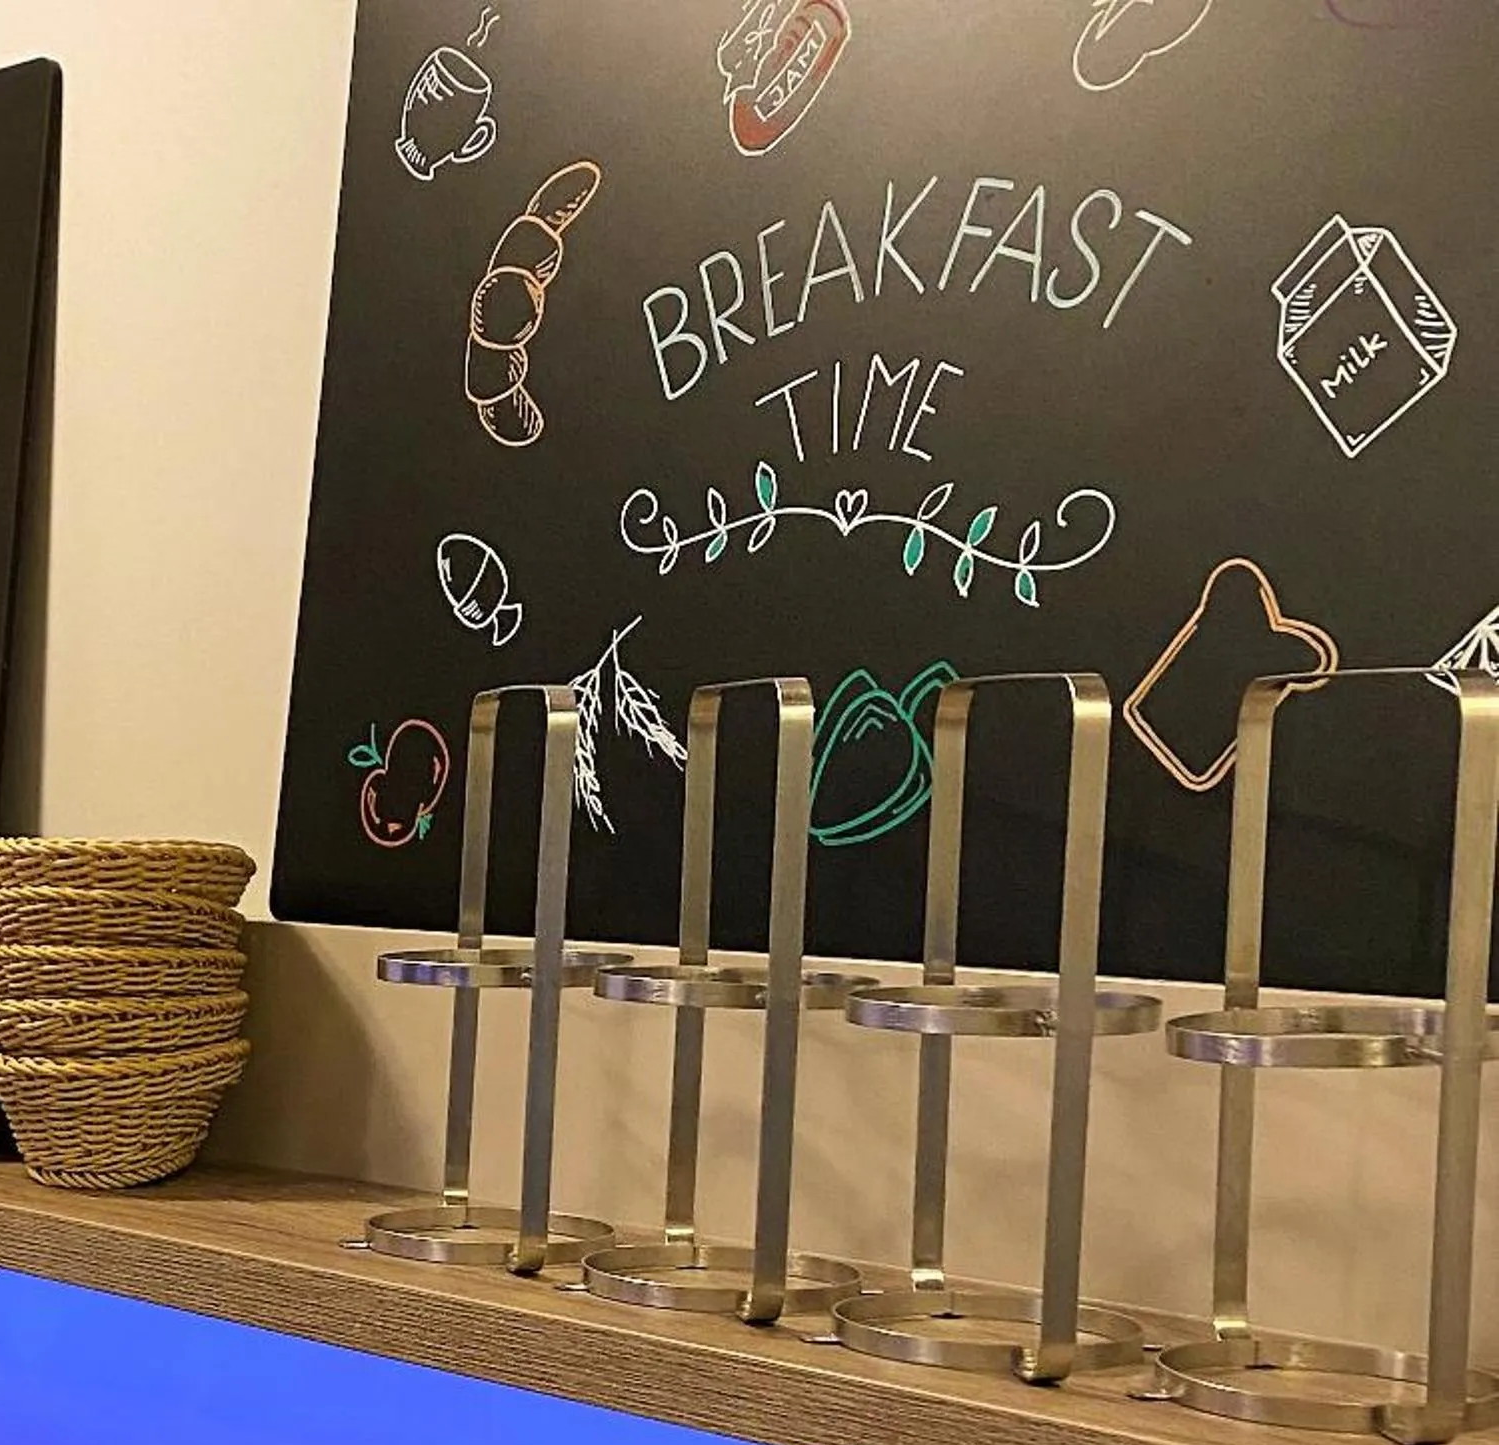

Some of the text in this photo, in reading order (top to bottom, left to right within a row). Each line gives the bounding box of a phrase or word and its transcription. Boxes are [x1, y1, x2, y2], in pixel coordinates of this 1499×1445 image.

[769, 38, 819, 107] JAM
[643, 175, 1193, 401] BREAKFAST
[755, 353, 965, 462] TIME
